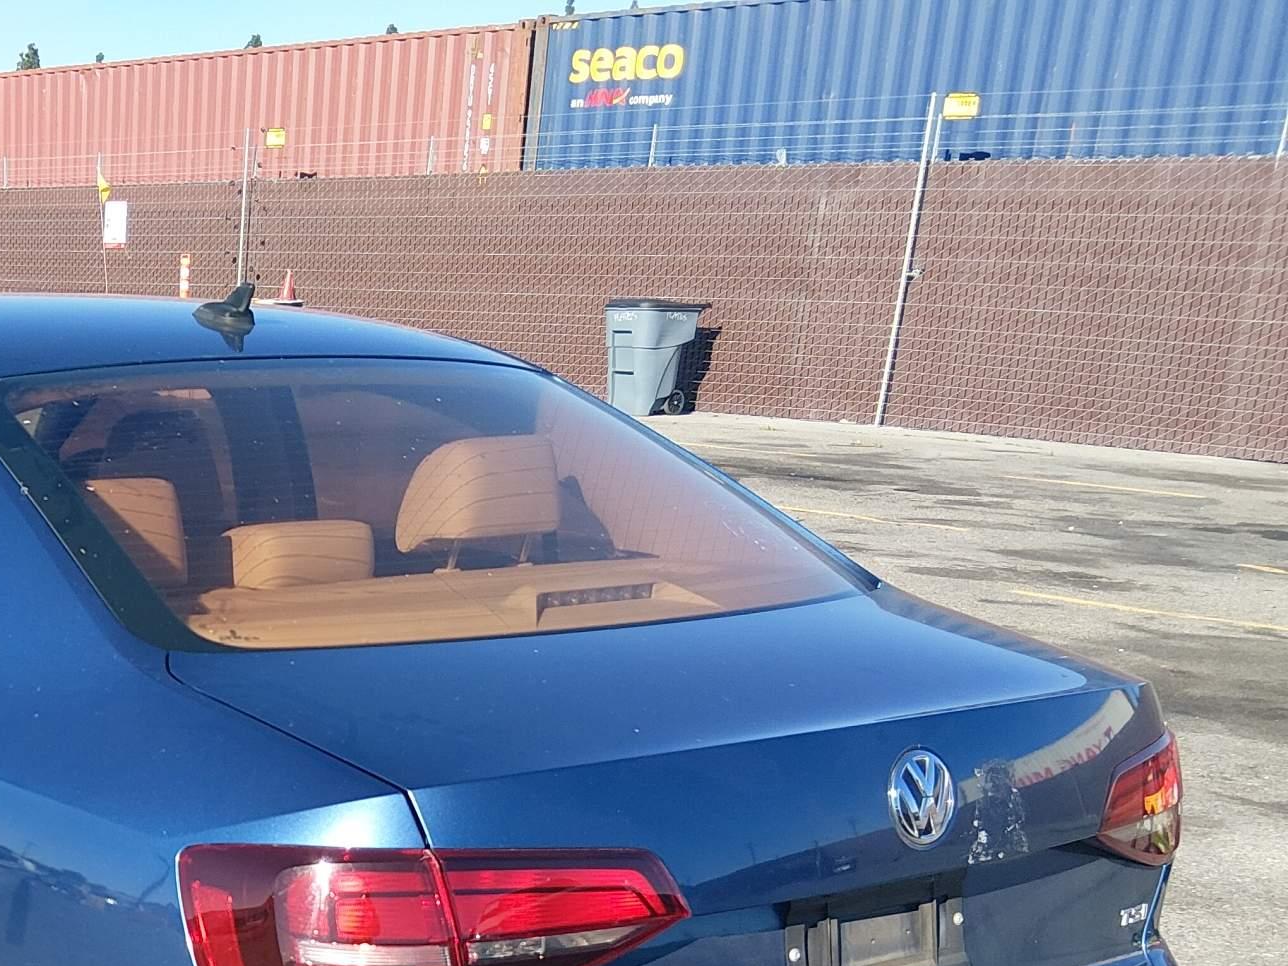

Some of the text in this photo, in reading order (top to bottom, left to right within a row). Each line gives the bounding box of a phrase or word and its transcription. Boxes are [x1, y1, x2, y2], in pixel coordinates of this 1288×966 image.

[569, 44, 684, 83] seaco
[570, 98, 584, 109] an
[628, 94, 673, 106] company
